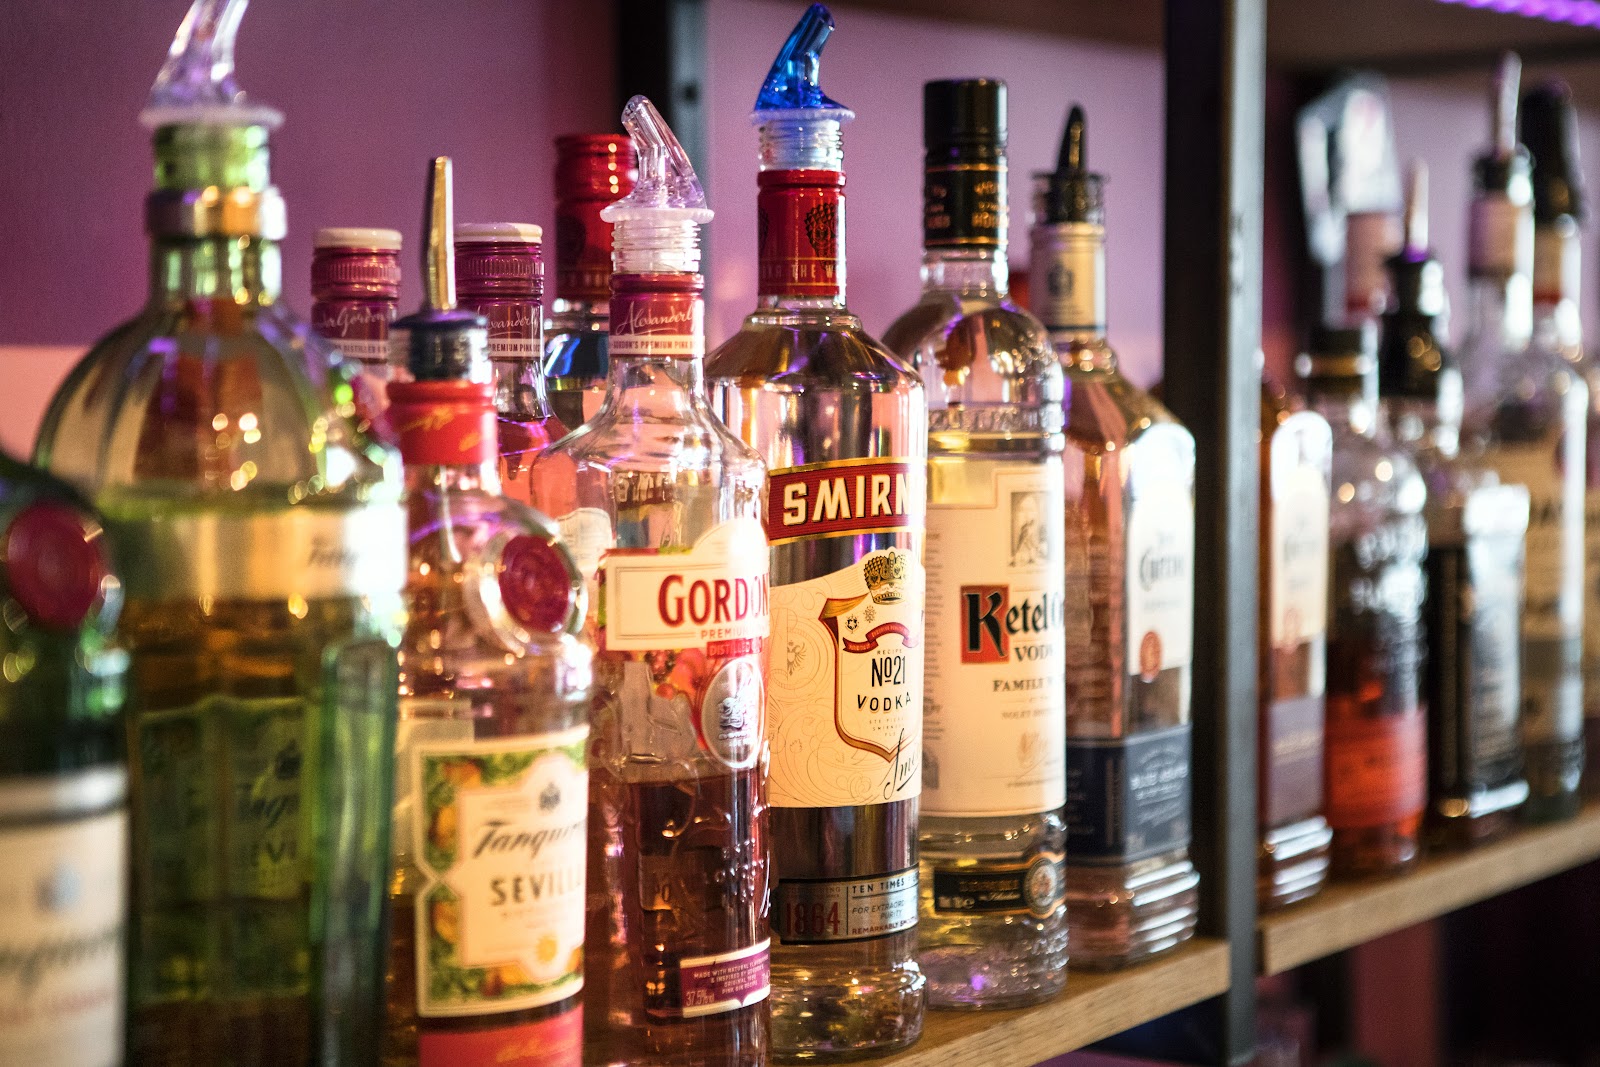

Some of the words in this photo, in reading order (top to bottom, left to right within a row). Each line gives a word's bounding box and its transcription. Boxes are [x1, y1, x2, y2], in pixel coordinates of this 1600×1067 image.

[791, 264, 816, 278] THE
[963, 591, 1049, 657] Ketel
[857, 691, 911, 712] VODKA
[852, 884, 874, 894] TEN
[879, 879, 905, 892] TIMES
[852, 906, 869, 914] FOR
[785, 901, 841, 936] 1864
[712, 968, 727, 977] WITH
